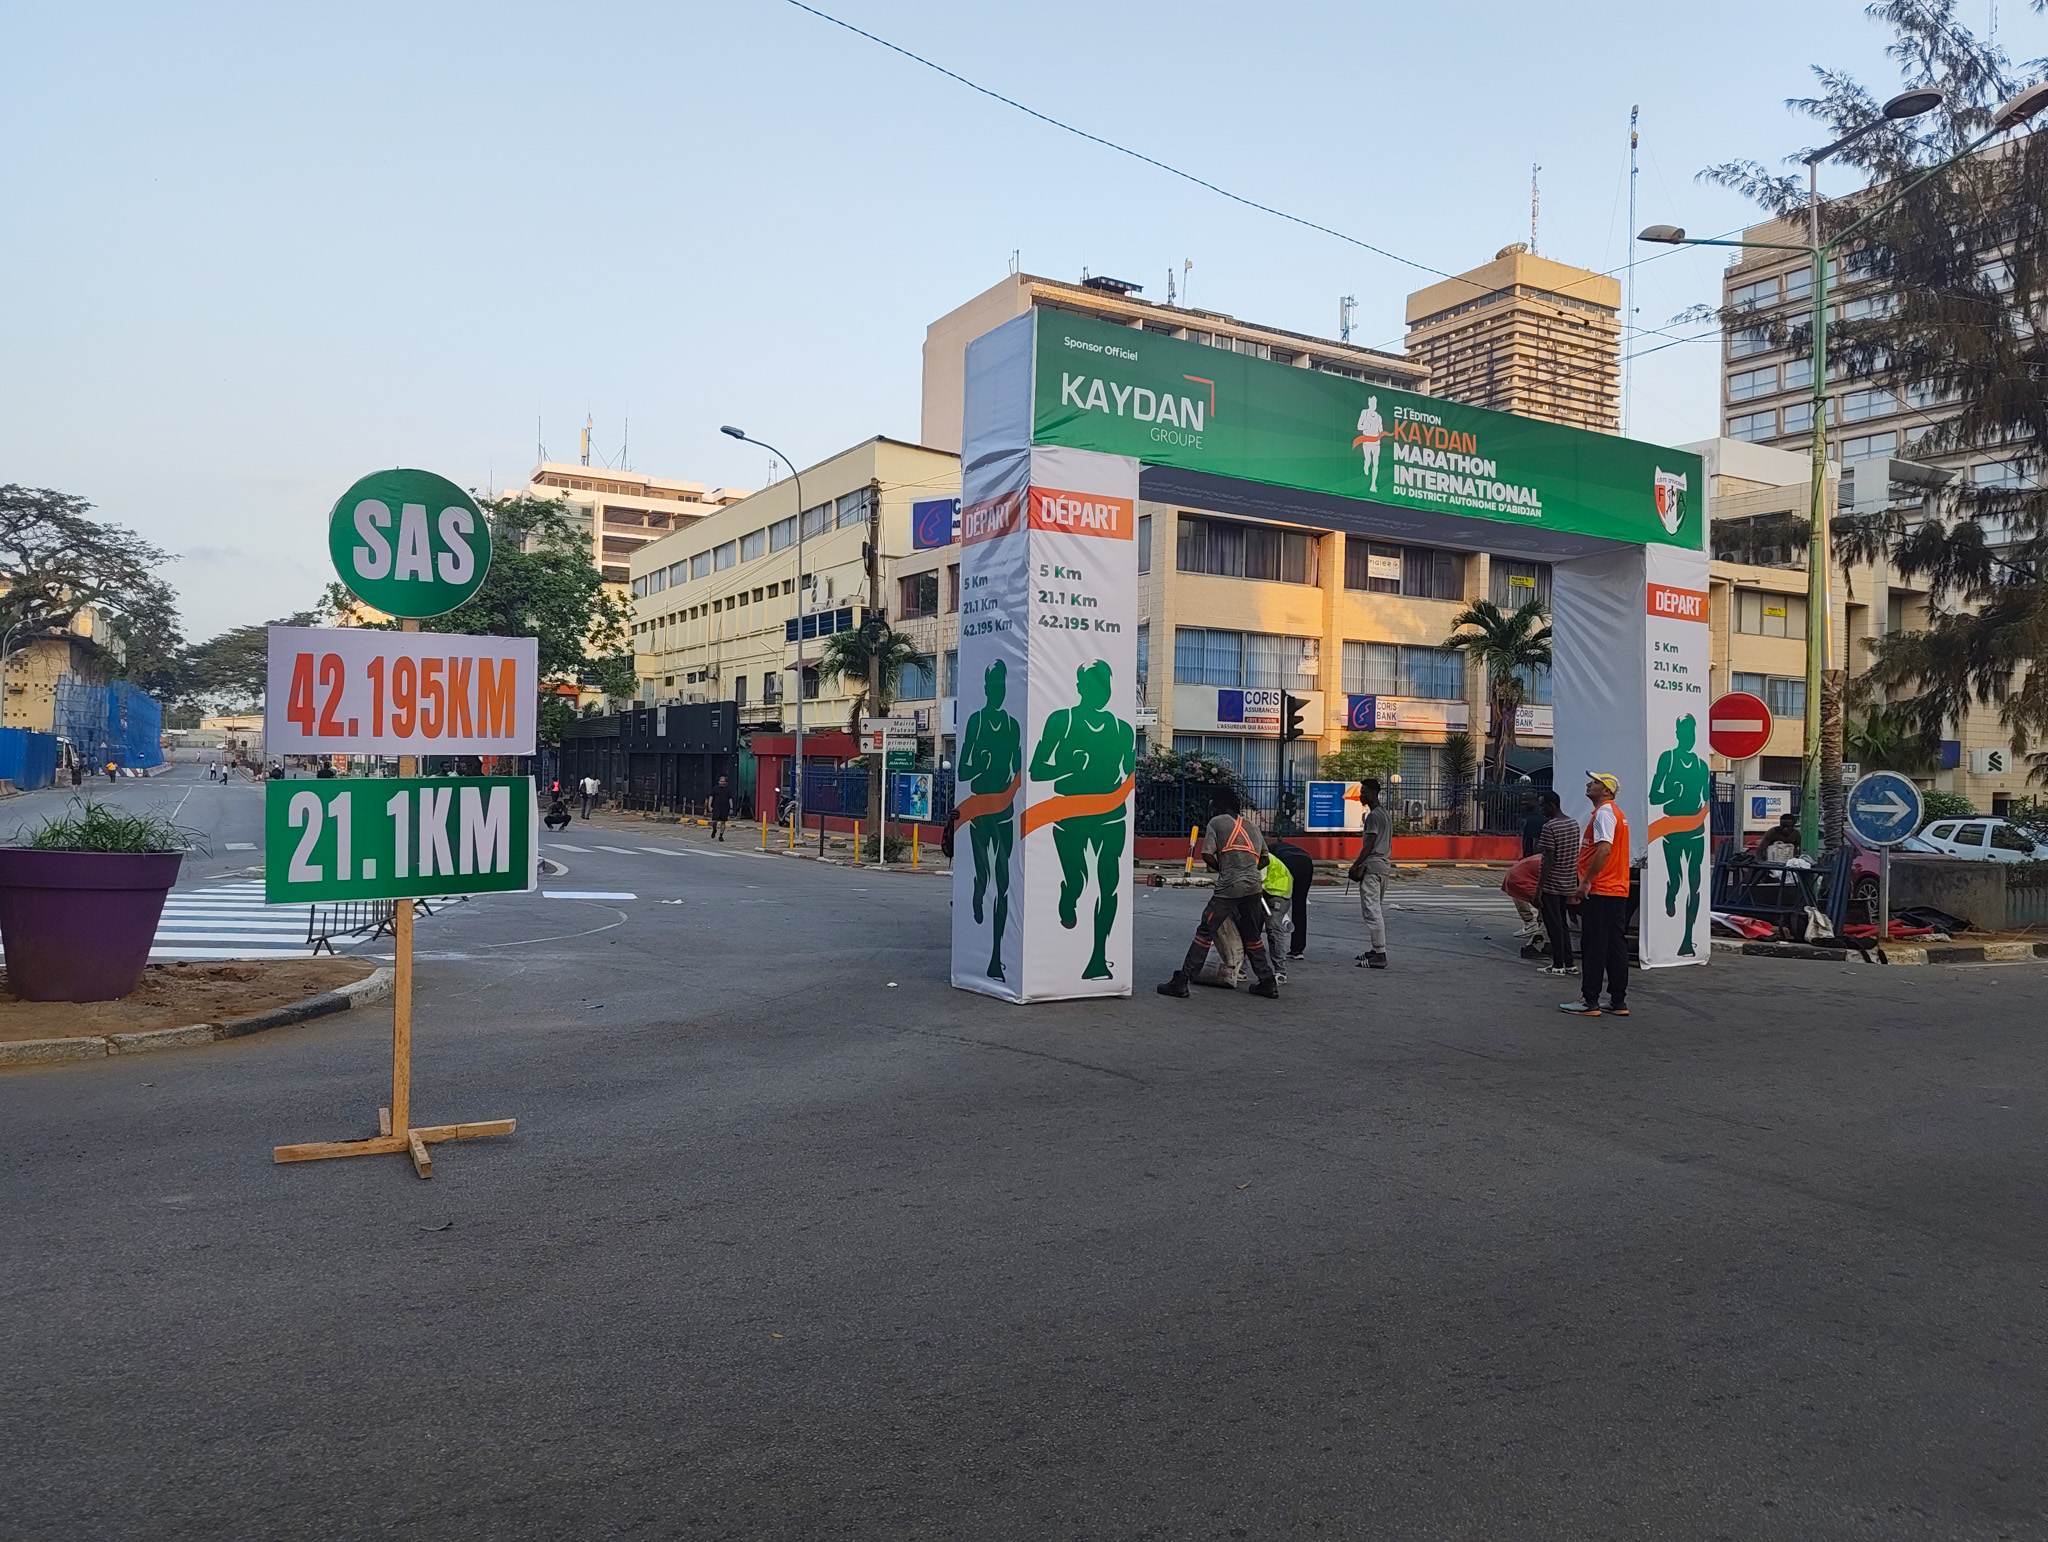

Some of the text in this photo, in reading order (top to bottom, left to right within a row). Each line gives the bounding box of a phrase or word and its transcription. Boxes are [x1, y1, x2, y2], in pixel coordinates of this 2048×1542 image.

[1064, 336, 1138, 361] Sponsor Officiel
[1061, 372, 1204, 432] KAYDAN
[1150, 427, 1204, 450] GROUPE
[1394, 418, 1477, 455] KAYDAN
[1393, 442, 1497, 478] MARATHON
[1393, 464, 1542, 508] INTERNATIONAL
[1393, 485, 1542, 518] DU DISTRICT AUTONOME D'ABIDJAN
[966, 500, 1012, 539] DÉPART
[1041, 494, 1120, 531] DÉPART
[352, 499, 475, 585] SAS
[1039, 564, 1082, 580] 5 Km
[964, 576, 988, 590] 5 Km
[963, 598, 998, 615] 21.1 Km
[1038, 590, 1098, 608] 21.1 Km
[1655, 589, 1702, 617] DÉPART
[963, 619, 1013, 637] 42.195 Km
[1038, 614, 1120, 633] 42.195 Km
[1654, 641, 1679, 654] 5 Km
[1653, 661, 1688, 674] 21.1 Km
[287, 652, 517, 740] 42.195KM
[1653, 679, 1702, 694] 42.195 Km
[1244, 691, 1280, 706] CORIS
[1376, 701, 1397, 711] CORIS
[1244, 706, 1280, 714] ASSURANCES
[1376, 711, 1397, 721] BANK
[1515, 718, 1533, 727] BANK
[287, 785, 511, 883] 21.1KM
